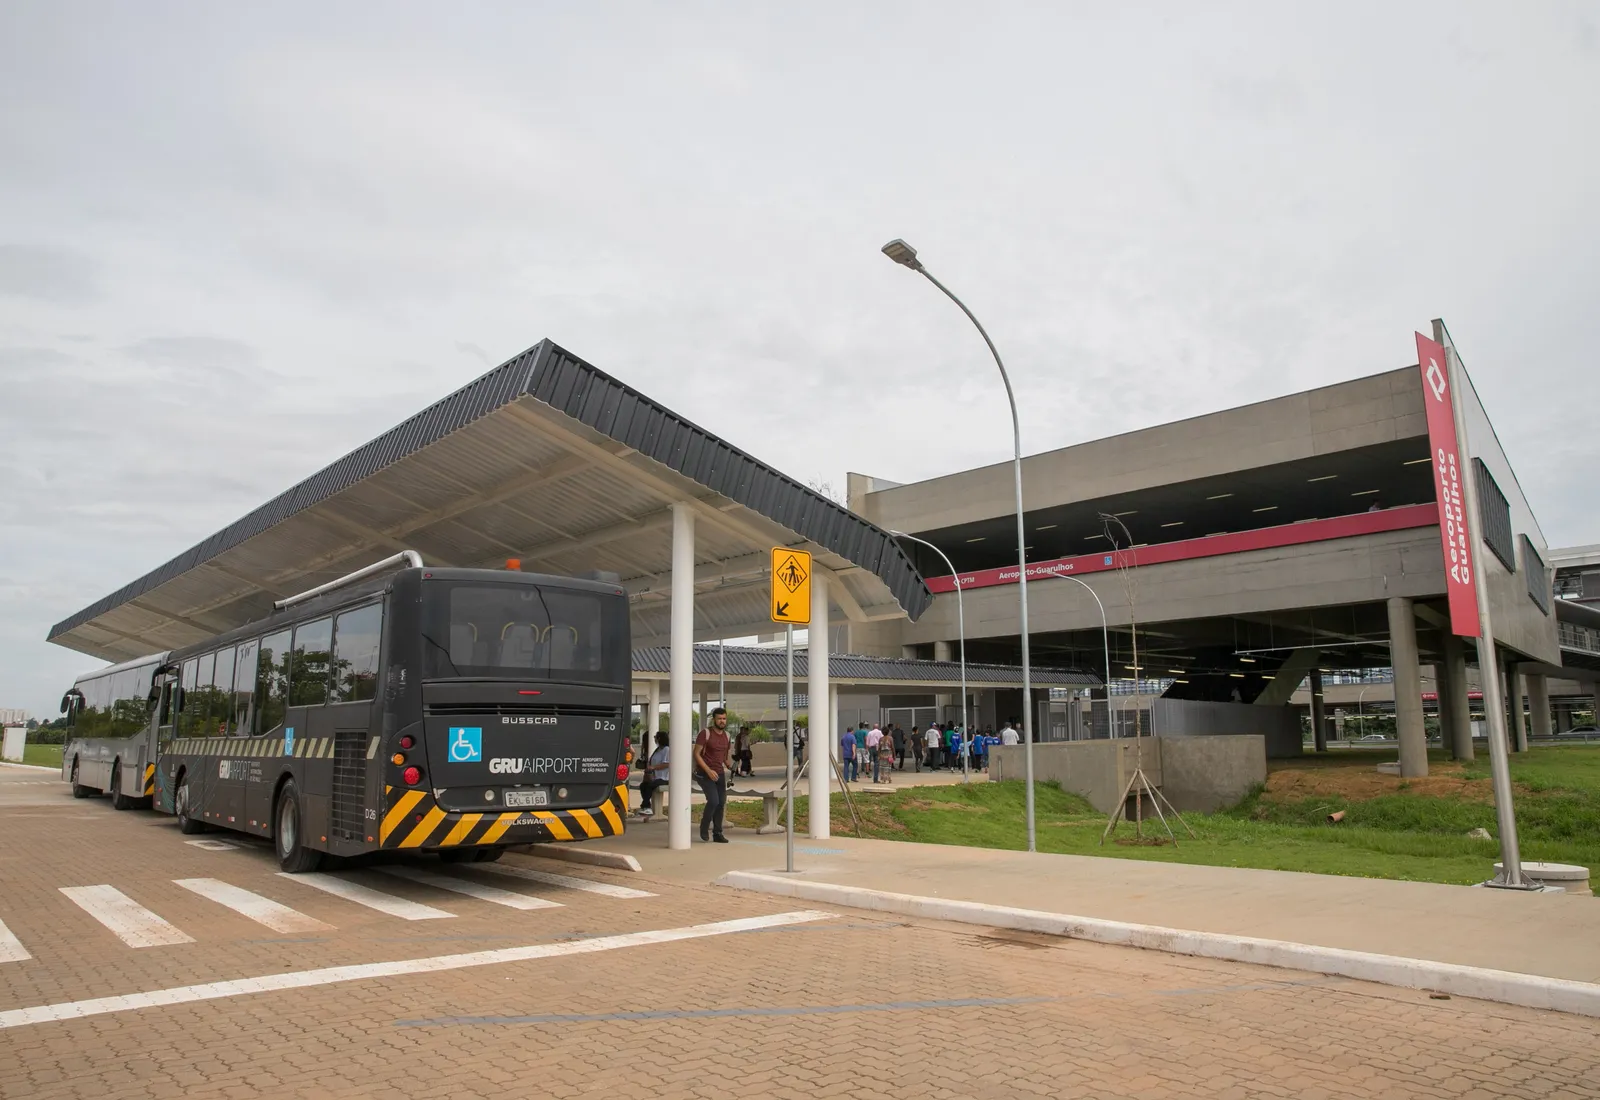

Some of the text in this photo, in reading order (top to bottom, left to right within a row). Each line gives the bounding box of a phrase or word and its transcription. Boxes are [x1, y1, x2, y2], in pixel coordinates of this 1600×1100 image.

[1438, 447, 1460, 583] Aeroporto
[1448, 453, 1469, 585] Guarulhos
[999, 563, 1074, 580] Aeropto-Guarulhos
[961, 577, 975, 585] CPTM
[501, 817, 555, 826] VOLKSWAGEN
